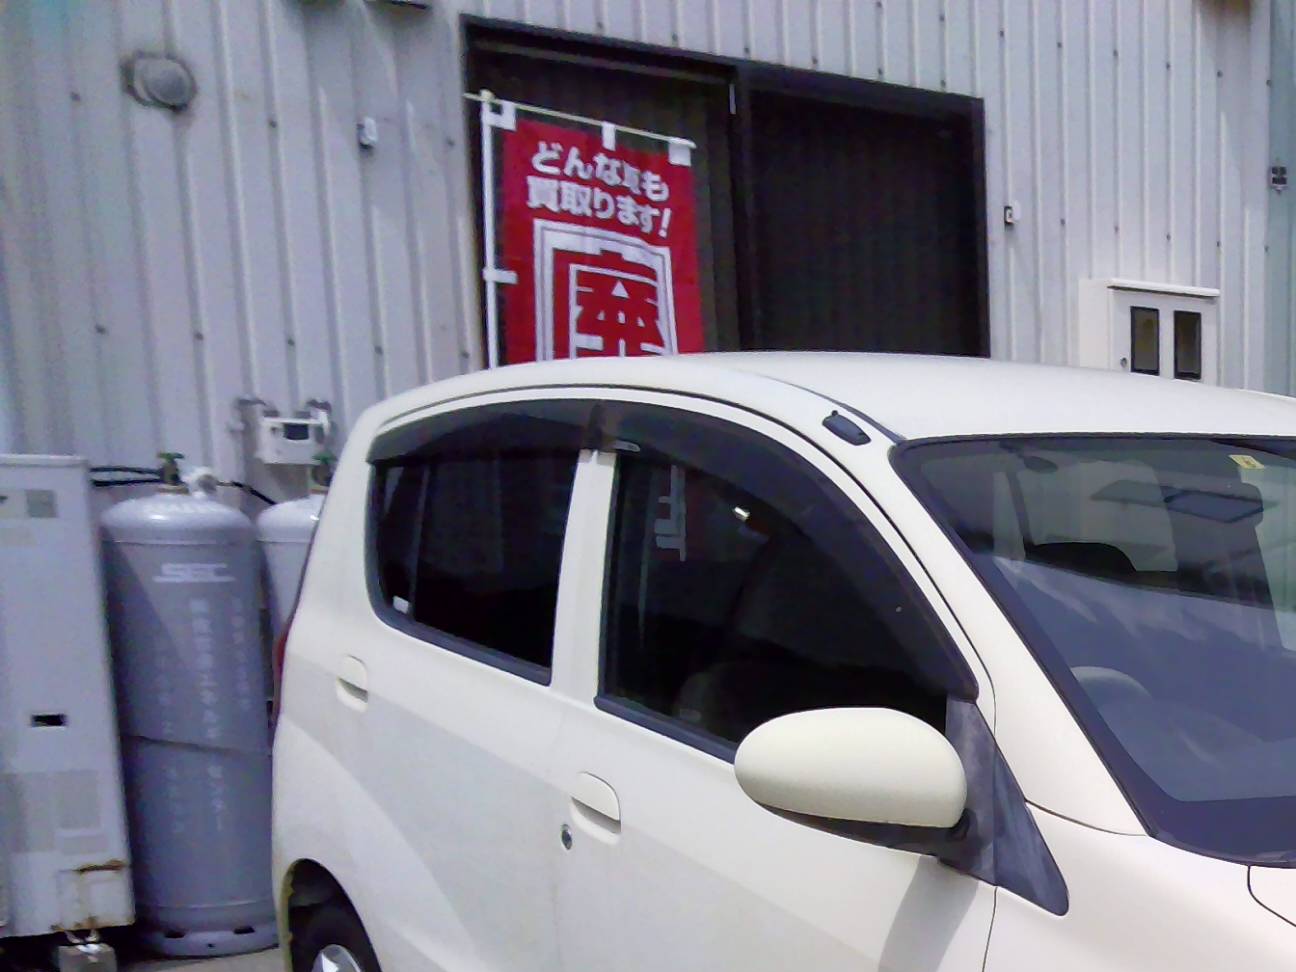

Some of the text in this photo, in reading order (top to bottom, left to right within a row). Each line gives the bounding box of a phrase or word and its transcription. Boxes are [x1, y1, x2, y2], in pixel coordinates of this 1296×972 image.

[531, 141, 669, 200] どんな車も
